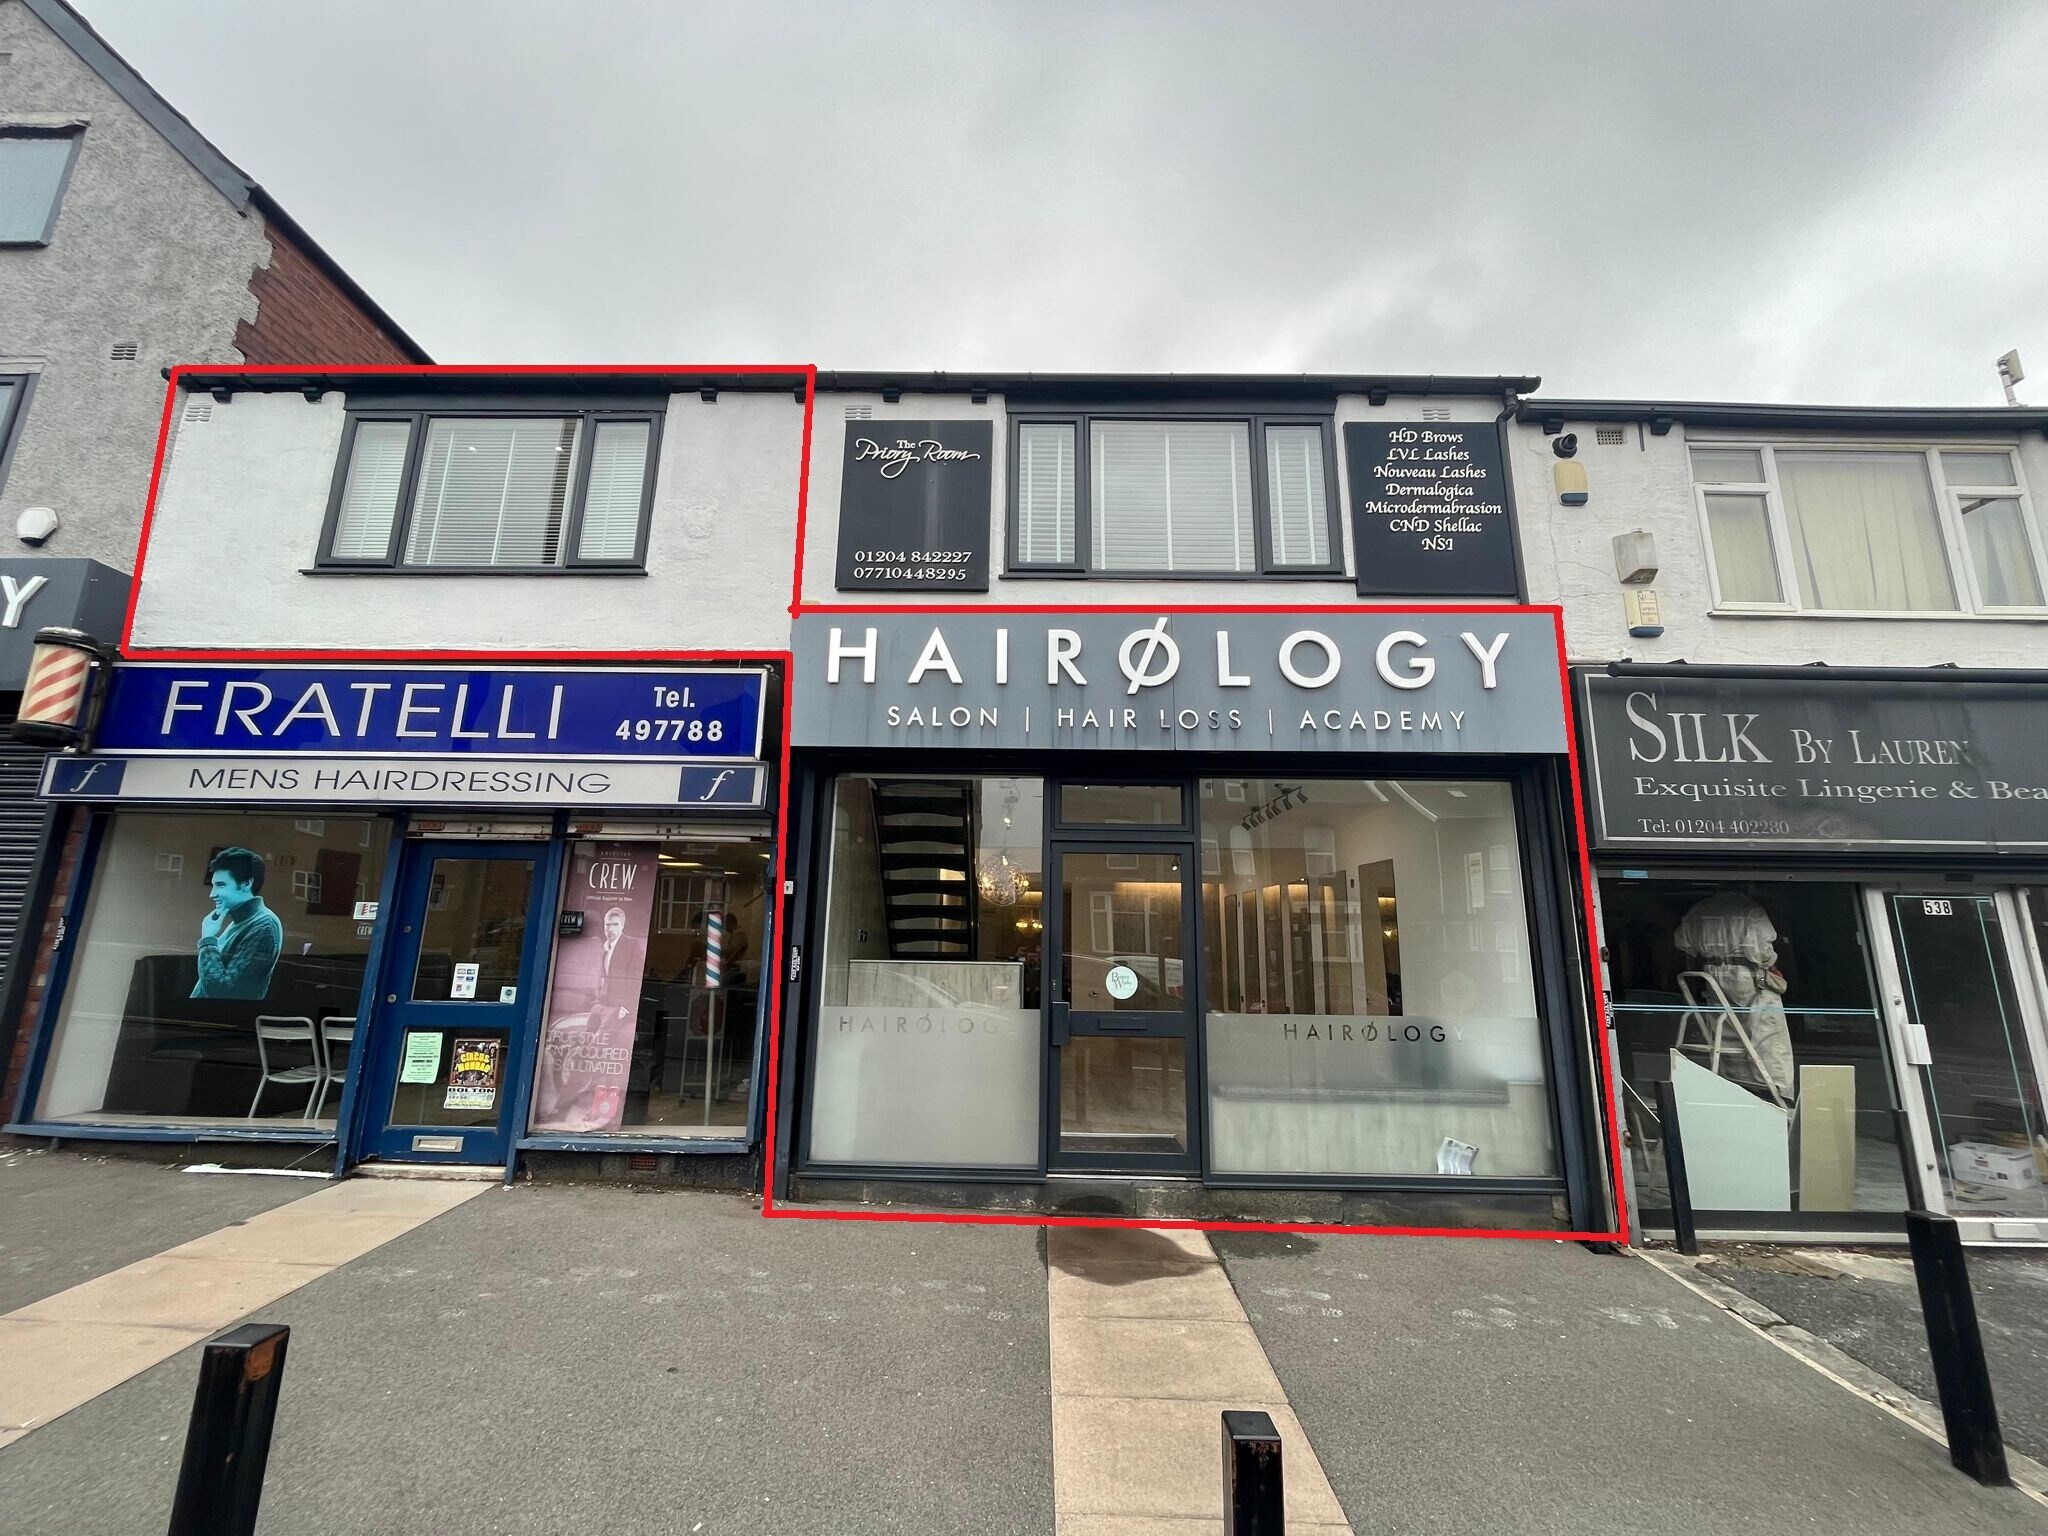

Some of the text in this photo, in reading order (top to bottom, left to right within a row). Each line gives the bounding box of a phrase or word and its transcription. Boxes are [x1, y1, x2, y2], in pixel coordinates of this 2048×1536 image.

[1389, 428, 1463, 443] HD Brows
[896, 440, 916, 449] The
[856, 438, 981, 479] Priory Room
[1387, 446, 1470, 461] LVL Lashes
[1374, 463, 1487, 478] Nouveau Lashes
[1386, 481, 1474, 500] Dermalogica
[1365, 499, 1502, 514] Microdermabrasion
[1390, 517, 1482, 532] CND Shellac
[1421, 535, 1454, 550] NSI
[855, 551, 972, 563] 01204 842227
[854, 567, 966, 580] 07710448295
[653, 686, 696, 708] Tel.
[160, 680, 563, 739] FRATELLI
[887, 706, 1466, 731] SALON HAIR LOSS ACADEMY
[615, 719, 723, 742] 497788
[1625, 690, 1773, 764] SILK
[189, 768, 611, 794] MENS HAIRDRESSING
[1633, 776, 1787, 801] Exquisite
[1796, 778, 1938, 803] Lingerie
[1949, 780, 1978, 799] &
[1637, 819, 1790, 835] Tel: 01204 402280
[589, 862, 637, 890] CREW
[1925, 901, 1951, 914] 538
